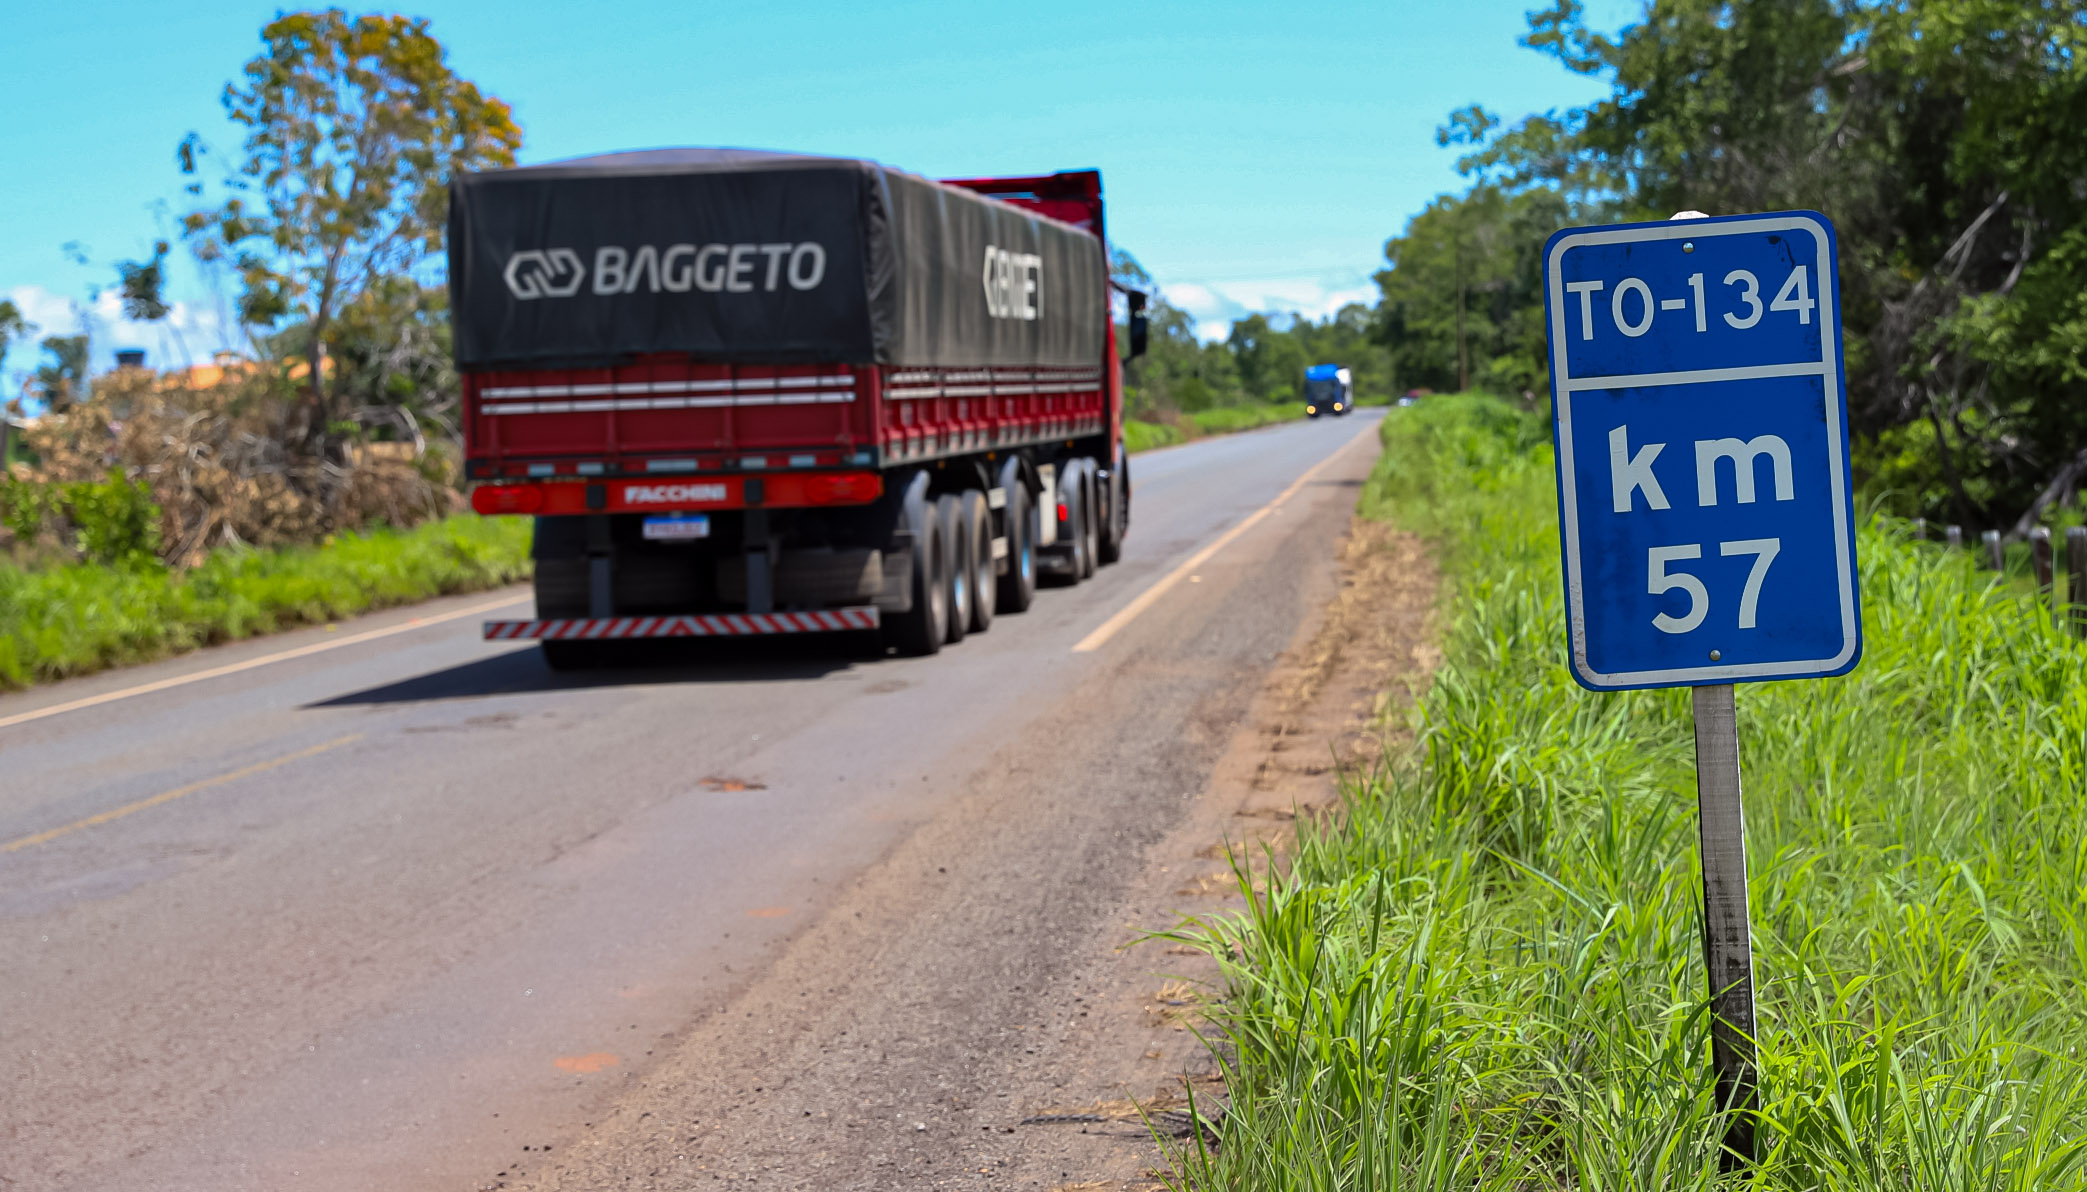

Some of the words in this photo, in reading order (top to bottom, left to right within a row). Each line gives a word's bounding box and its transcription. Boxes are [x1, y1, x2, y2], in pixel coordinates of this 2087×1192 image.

[592, 242, 826, 295] BAGGETO
[1566, 265, 1815, 341] TO-134
[624, 483, 727, 504] FACCHINI
[1608, 424, 1794, 513] km
[1647, 537, 1781, 634] 57
